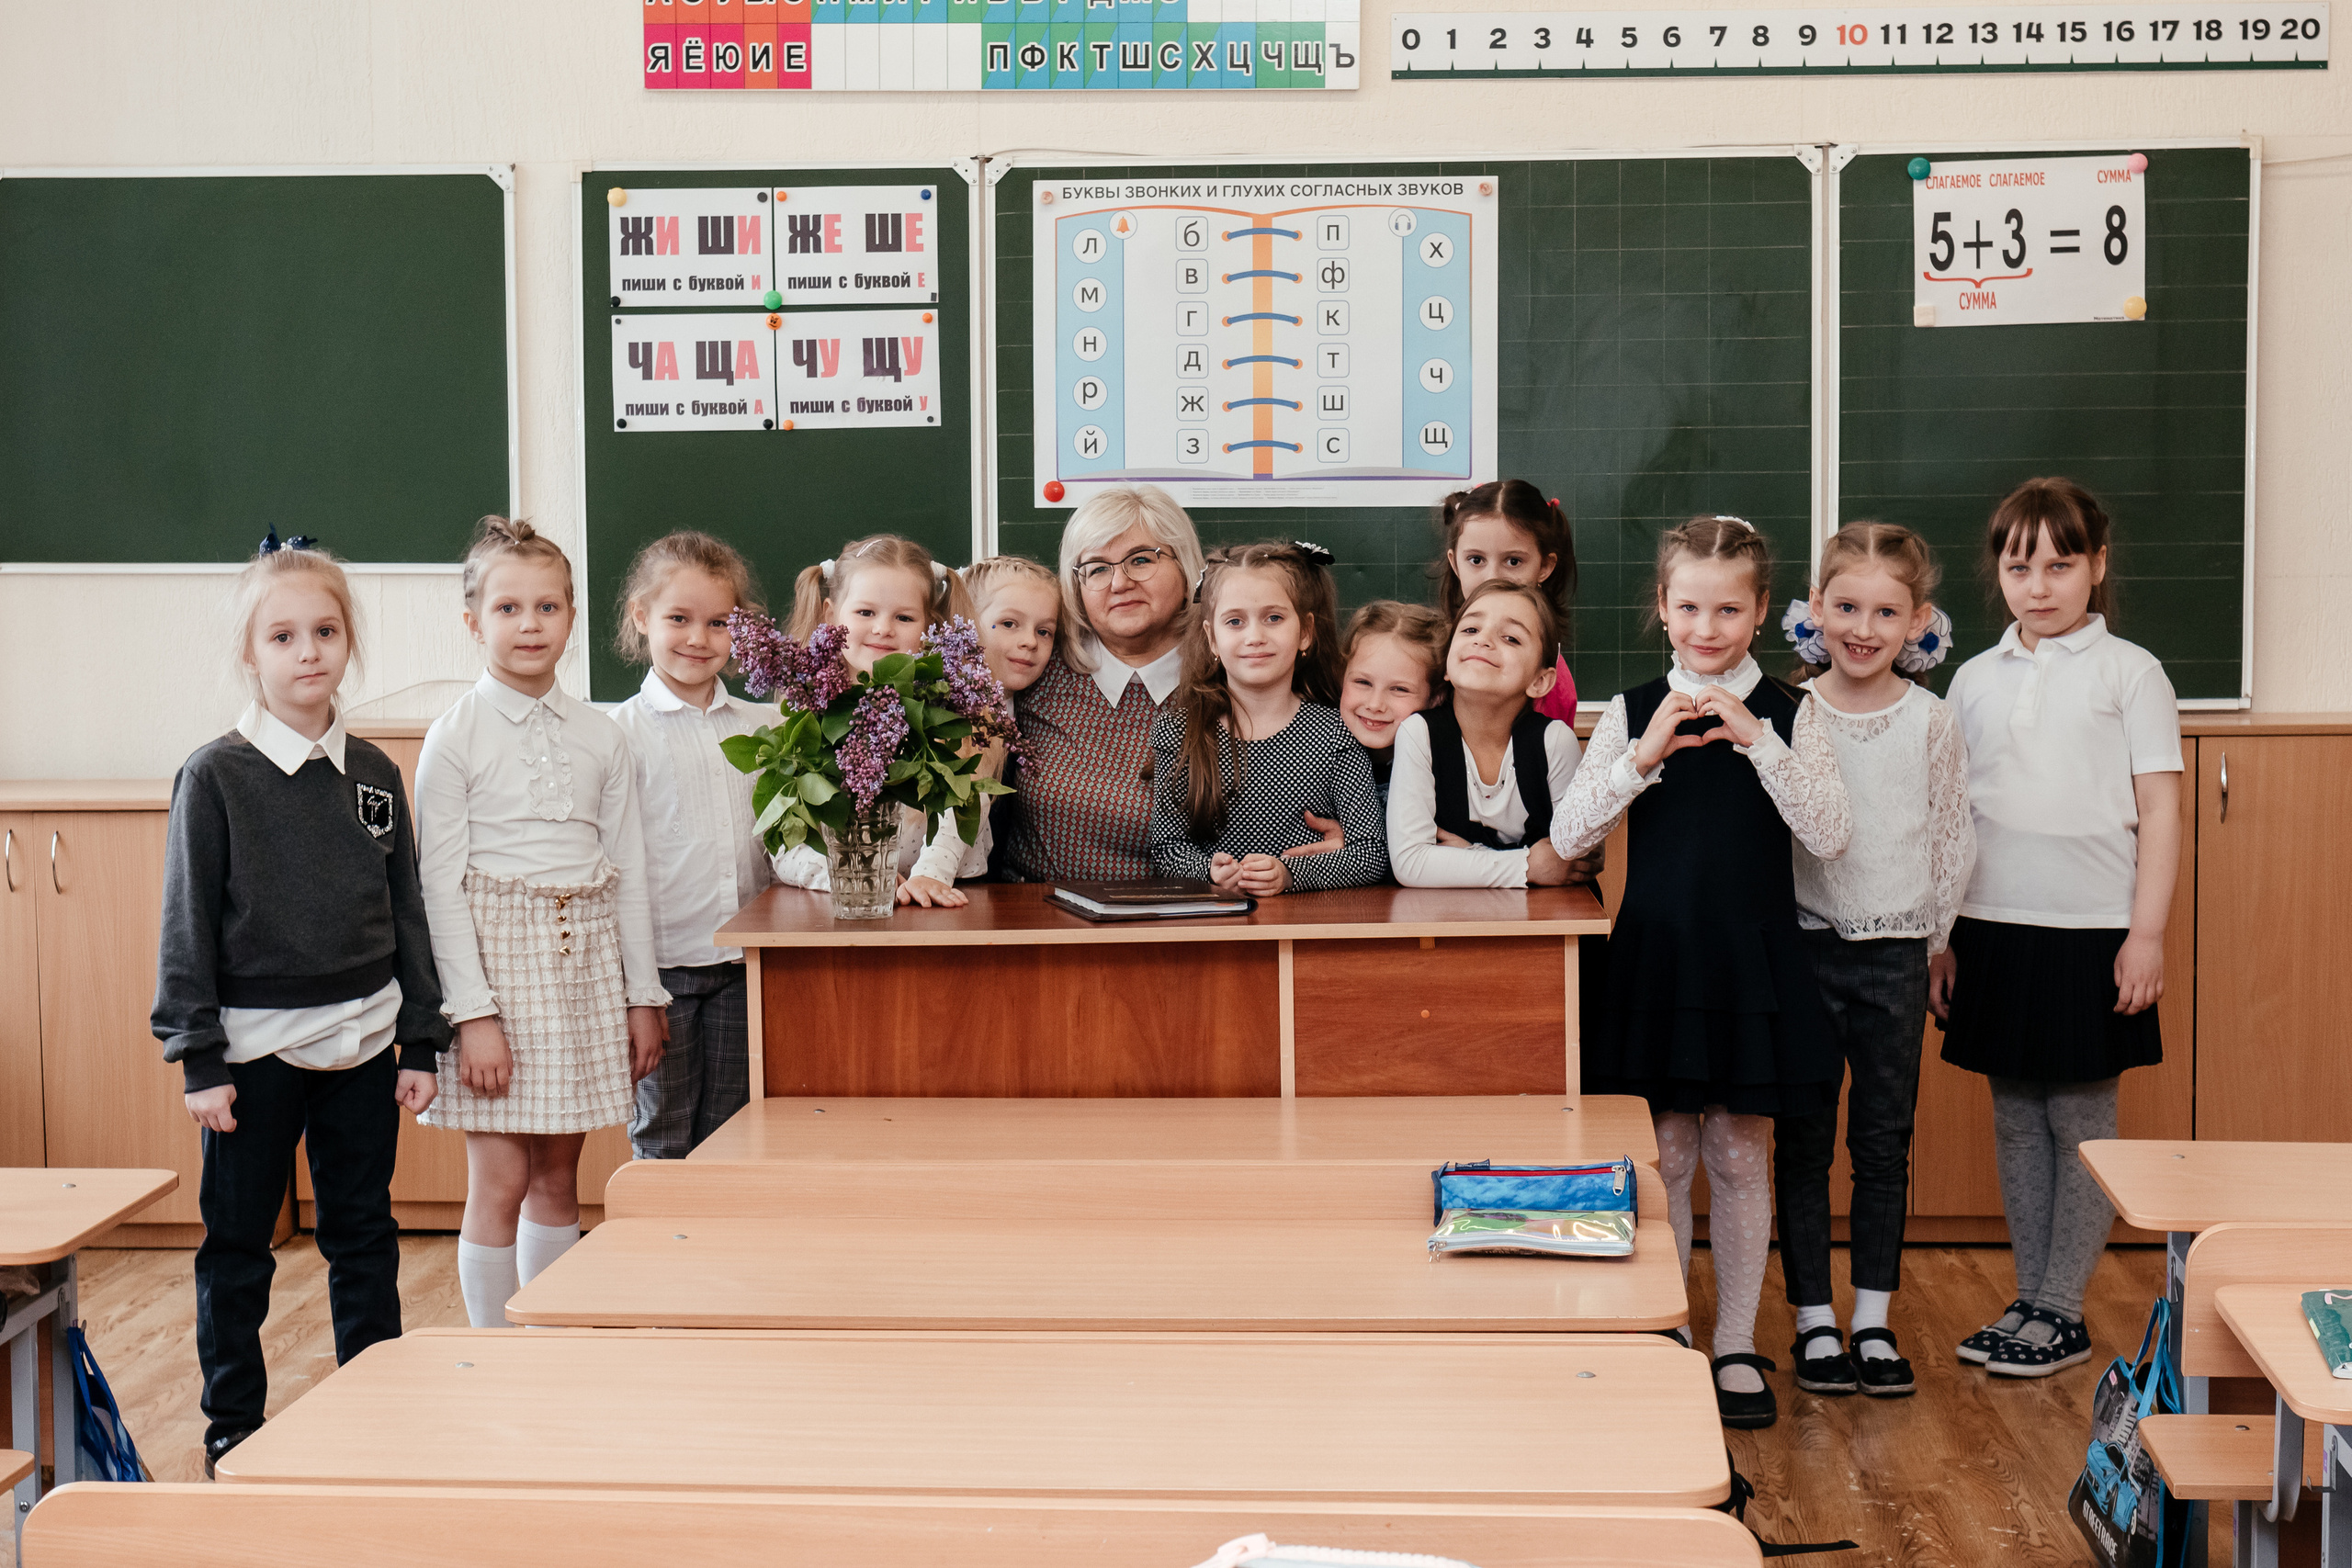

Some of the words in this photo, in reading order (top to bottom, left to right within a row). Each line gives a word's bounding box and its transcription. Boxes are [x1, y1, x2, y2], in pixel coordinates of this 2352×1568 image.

[1402, 29, 1420, 51] 0
[1447, 29, 1455, 50] 1
[1489, 28, 1507, 50] 2
[1534, 28, 1551, 50] 3
[1576, 28, 1594, 49] 4
[1621, 28, 1637, 49] 5
[1663, 27, 1680, 48] 6
[1710, 26, 1727, 48] 7
[1752, 26, 1770, 47] 8
[1799, 25, 1816, 47] 9
[1837, 24, 1868, 46] 10
[1881, 24, 1906, 45] 11
[1923, 23, 1953, 45] 12
[1969, 22, 1997, 44] 13
[2013, 22, 2044, 43] 14
[2057, 21, 2086, 43] 15
[2103, 20, 2134, 42] 16
[2149, 20, 2179, 42] 17
[2193, 19, 2222, 41] 18
[2239, 19, 2270, 41] 19
[2280, 18, 2320, 40] 20
[650, 46, 669, 70] Я
[685, 39, 703, 70] Ё
[716, 45, 740, 69] Ю
[752, 46, 770, 69] И
[787, 45, 804, 69] Е
[989, 45, 1008, 69] П
[1021, 45, 1045, 69] Ф
[1060, 45, 1077, 69] К
[1092, 45, 1110, 69] Т
[1122, 44, 1149, 68] Ш
[1160, 44, 1180, 69] С
[1194, 44, 1215, 68] Х
[1229, 44, 1250, 73] Ц
[1264, 43, 1283, 68] Ч
[1295, 43, 1321, 73] Щ
[1329, 43, 1354, 67] Ъ
[1926, 174, 1982, 189] СЛАГАЕМОЕ
[1990, 172, 2045, 186] СЛАГАЕМОЕ
[2098, 169, 2132, 183] СУММА
[1063, 186, 1119, 198] БУКВЫ
[1125, 186, 1201, 197] ЗВОНКИХ
[1207, 186, 1216, 197] И
[1223, 185, 1284, 197] ГЛУХИХ
[1291, 184, 1392, 197] СОГЛАСНЫХ
[1397, 183, 1464, 196] ЗВУКОВ
[620, 217, 679, 255] ЖИ
[697, 216, 761, 255] ШИ
[788, 214, 842, 254] ЖЕ
[865, 213, 923, 253] ШЕ
[1184, 220, 1200, 246] б
[1328, 225, 1340, 241] п
[2104, 205, 2128, 265] 8
[1083, 238, 1097, 254] л
[1430, 243, 1443, 258] х
[622, 278, 666, 291] пиши
[673, 278, 682, 290] с
[689, 274, 744, 292] буквой
[752, 275, 761, 289] И
[788, 276, 831, 289] пиши
[839, 276, 847, 288] с
[854, 272, 910, 289] буквой
[918, 273, 925, 288] Е
[1186, 268, 1198, 284] в
[1320, 261, 1345, 288] ф
[1081, 288, 1098, 303] м
[1960, 292, 1996, 310] СУММА
[1187, 310, 1197, 326] г
[1327, 310, 1340, 326] к
[1430, 303, 1443, 323] ц
[1084, 336, 1096, 352] н
[628, 342, 679, 380] ЧА
[695, 341, 760, 386] ЩА
[793, 339, 840, 378] ЧУ
[863, 336, 923, 382] ЩУ
[1184, 351, 1201, 371] д
[1328, 353, 1340, 368] т
[1430, 367, 1442, 383] ч
[1083, 382, 1097, 404] р
[626, 403, 669, 416] пиши
[676, 403, 684, 415] с
[692, 399, 747, 416] буквой
[754, 400, 763, 414] А
[790, 400, 834, 413] пиши
[842, 400, 850, 412] с
[857, 395, 912, 413] буквой
[920, 396, 927, 411] У
[1182, 396, 1204, 412] ж
[1323, 395, 1343, 411] ш
[1084, 431, 1097, 454] й
[1186, 438, 1199, 454] з
[1327, 437, 1340, 453] с
[1425, 428, 1448, 448] щ
